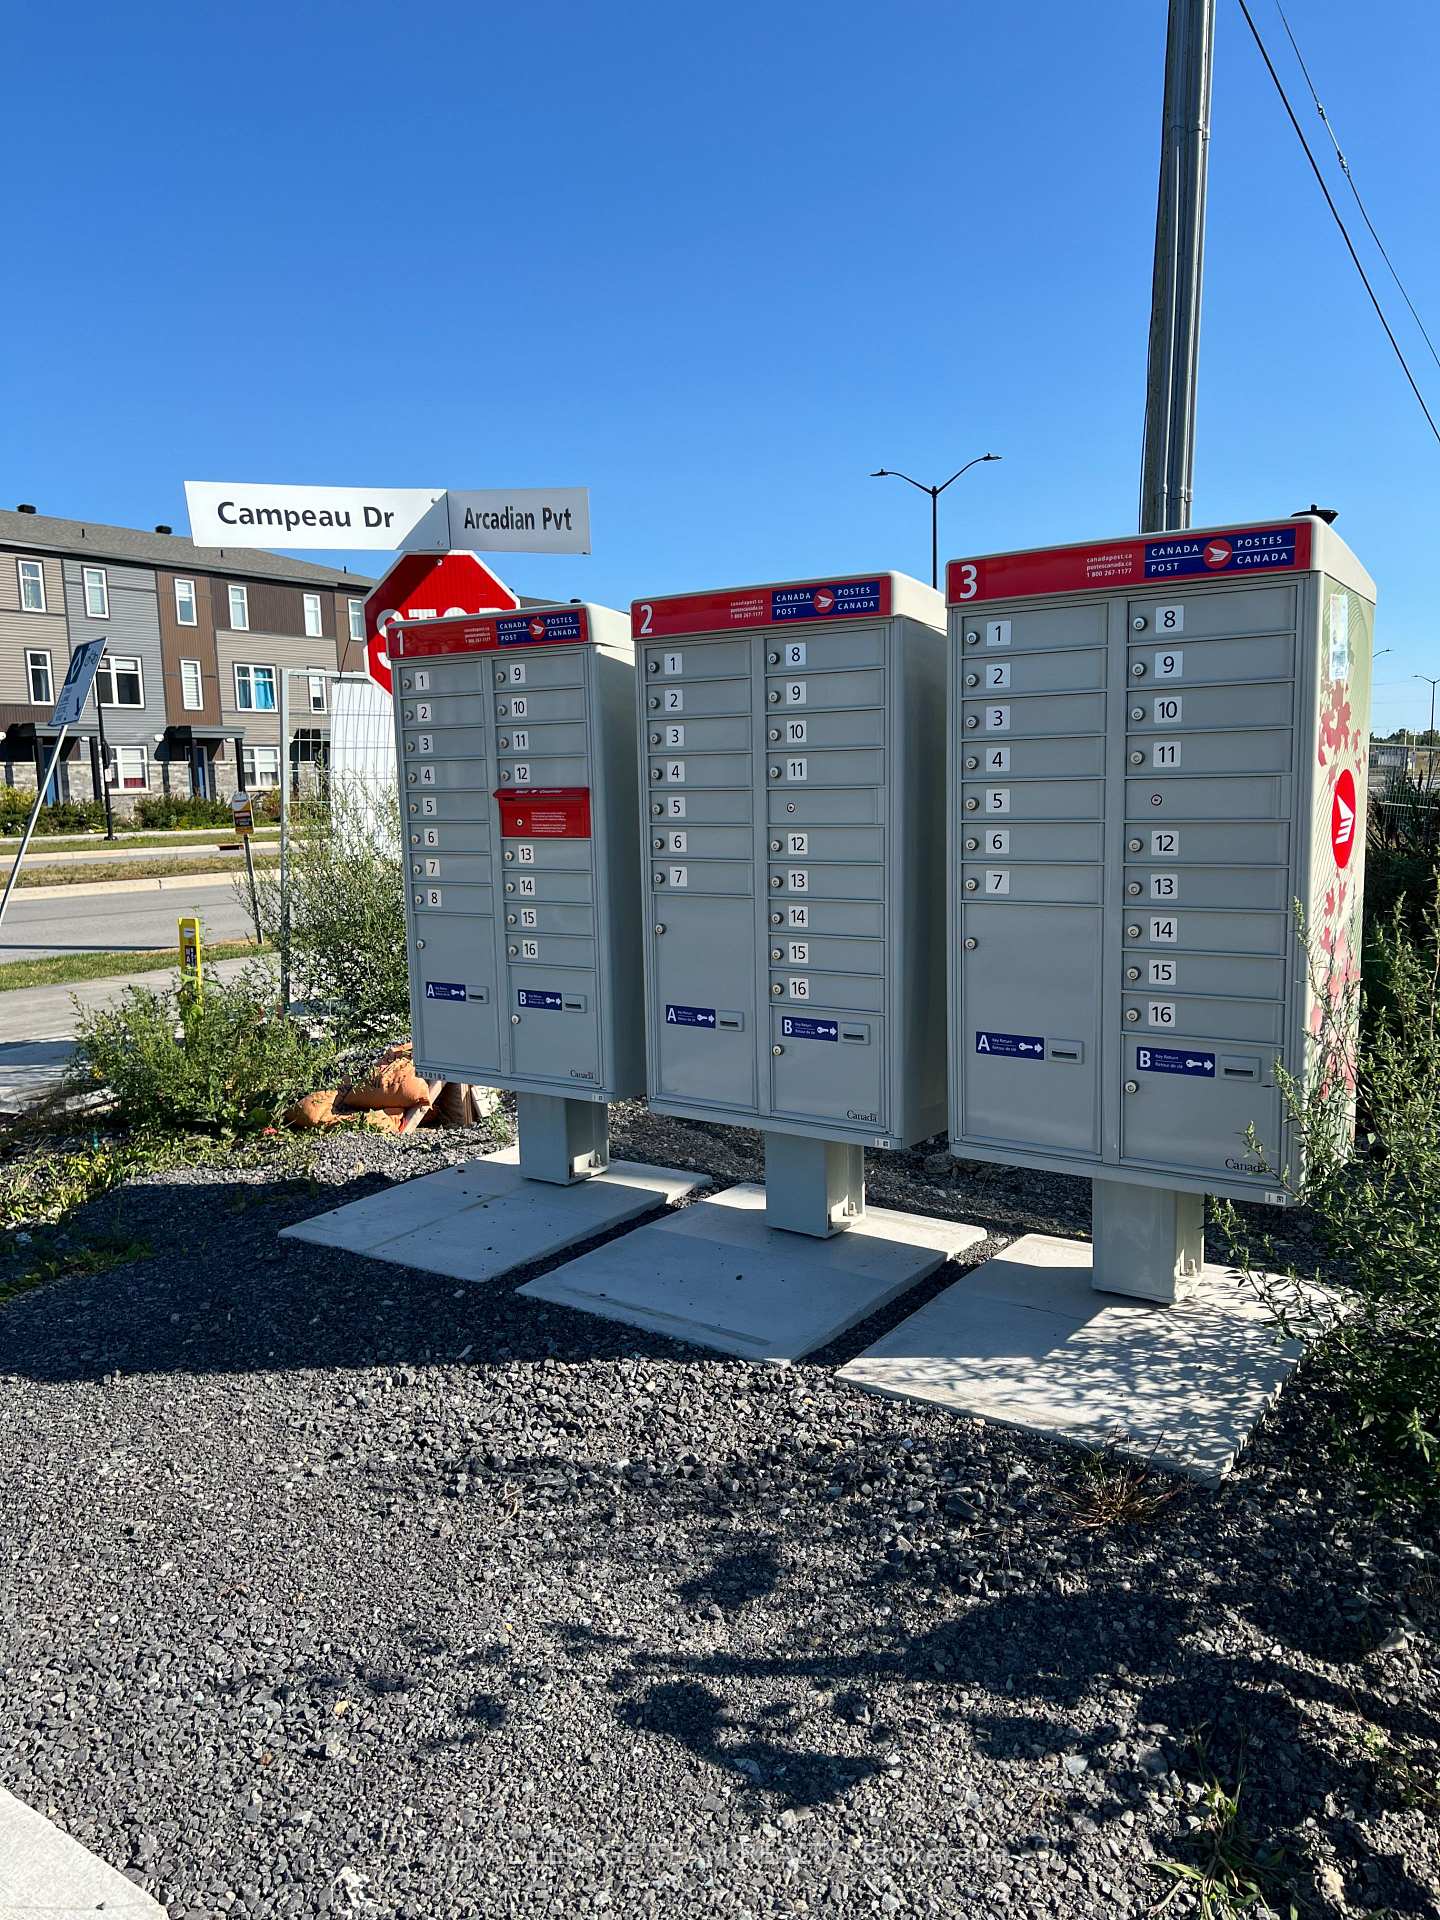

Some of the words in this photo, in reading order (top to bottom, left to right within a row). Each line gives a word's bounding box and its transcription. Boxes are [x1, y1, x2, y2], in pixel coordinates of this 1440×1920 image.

[217, 501, 352, 532] Campeau
[363, 506, 394, 528] Dr
[463, 505, 536, 531] Arcadian
[541, 506, 573, 531] Pvt
[1237, 535, 1283, 547] POSTES
[1151, 544, 1200, 557] CANADA
[1236, 551, 1288, 565] CANADA
[1151, 562, 1180, 573] POST
[959, 564, 978, 600] 3
[776, 592, 811, 602] CANADA
[838, 586, 871, 596] POSTES
[776, 607, 797, 616] POST
[837, 600, 874, 610] CANADA
[499, 621, 527, 630] CANADA
[546, 616, 573, 625] POSTES
[639, 604, 653, 634] 2
[1163, 610, 1176, 628] 8
[501, 633, 517, 641] POST
[548, 628, 577, 637] CANADA
[995, 625, 1001, 642] 1
[396, 630, 404, 655] 1
[791, 646, 801, 662] 8
[670, 656, 676, 671] 1
[1163, 655, 1175, 674] 9
[419, 674, 424, 687] 1
[514, 667, 521, 681] 9
[993, 667, 1004, 685] 2
[670, 693, 678, 708] 2
[791, 685, 801, 701] 9
[421, 706, 428, 719] 2
[513, 700, 525, 714] 10
[1158, 700, 1178, 719] 10
[993, 710, 1003, 727] 3
[671, 728, 679, 744] 3
[789, 723, 804, 739] 10
[423, 737, 430, 751] 3
[515, 734, 526, 747] 11
[991, 751, 1004, 768] 4
[1158, 745, 1175, 763] 11
[424, 769, 431, 782] 4
[516, 767, 528, 780] 12
[671, 764, 680, 779] 4
[790, 762, 803, 777] 11
[426, 800, 433, 813] 5
[673, 799, 681, 814] 5
[993, 792, 1003, 809] 5
[428, 831, 435, 844] 6
[674, 835, 682, 849] 6
[791, 836, 805, 851] 12
[992, 833, 1003, 850] 6
[1155, 834, 1174, 852] 12
[520, 847, 532, 861] 13
[429, 861, 436, 874] 7
[674, 869, 683, 884] 7
[791, 873, 805, 888] 13
[992, 874, 1003, 890] 7
[521, 880, 533, 893] 14
[1154, 878, 1174, 895] 13
[431, 891, 438, 904] 8
[522, 911, 535, 924] 15
[790, 909, 806, 924] 14
[1153, 921, 1174, 938] 14
[524, 943, 536, 956] 16
[791, 945, 806, 960] 15
[1152, 963, 1172, 981] 15
[427, 984, 435, 997] A
[791, 981, 807, 996] 16
[519, 991, 527, 1004] B
[667, 1007, 677, 1022] A
[1151, 1006, 1172, 1024] 16
[784, 1019, 793, 1034] B
[977, 1034, 991, 1051] A
[1139, 1050, 1151, 1068] B
[846, 1109, 878, 1123] Canada
